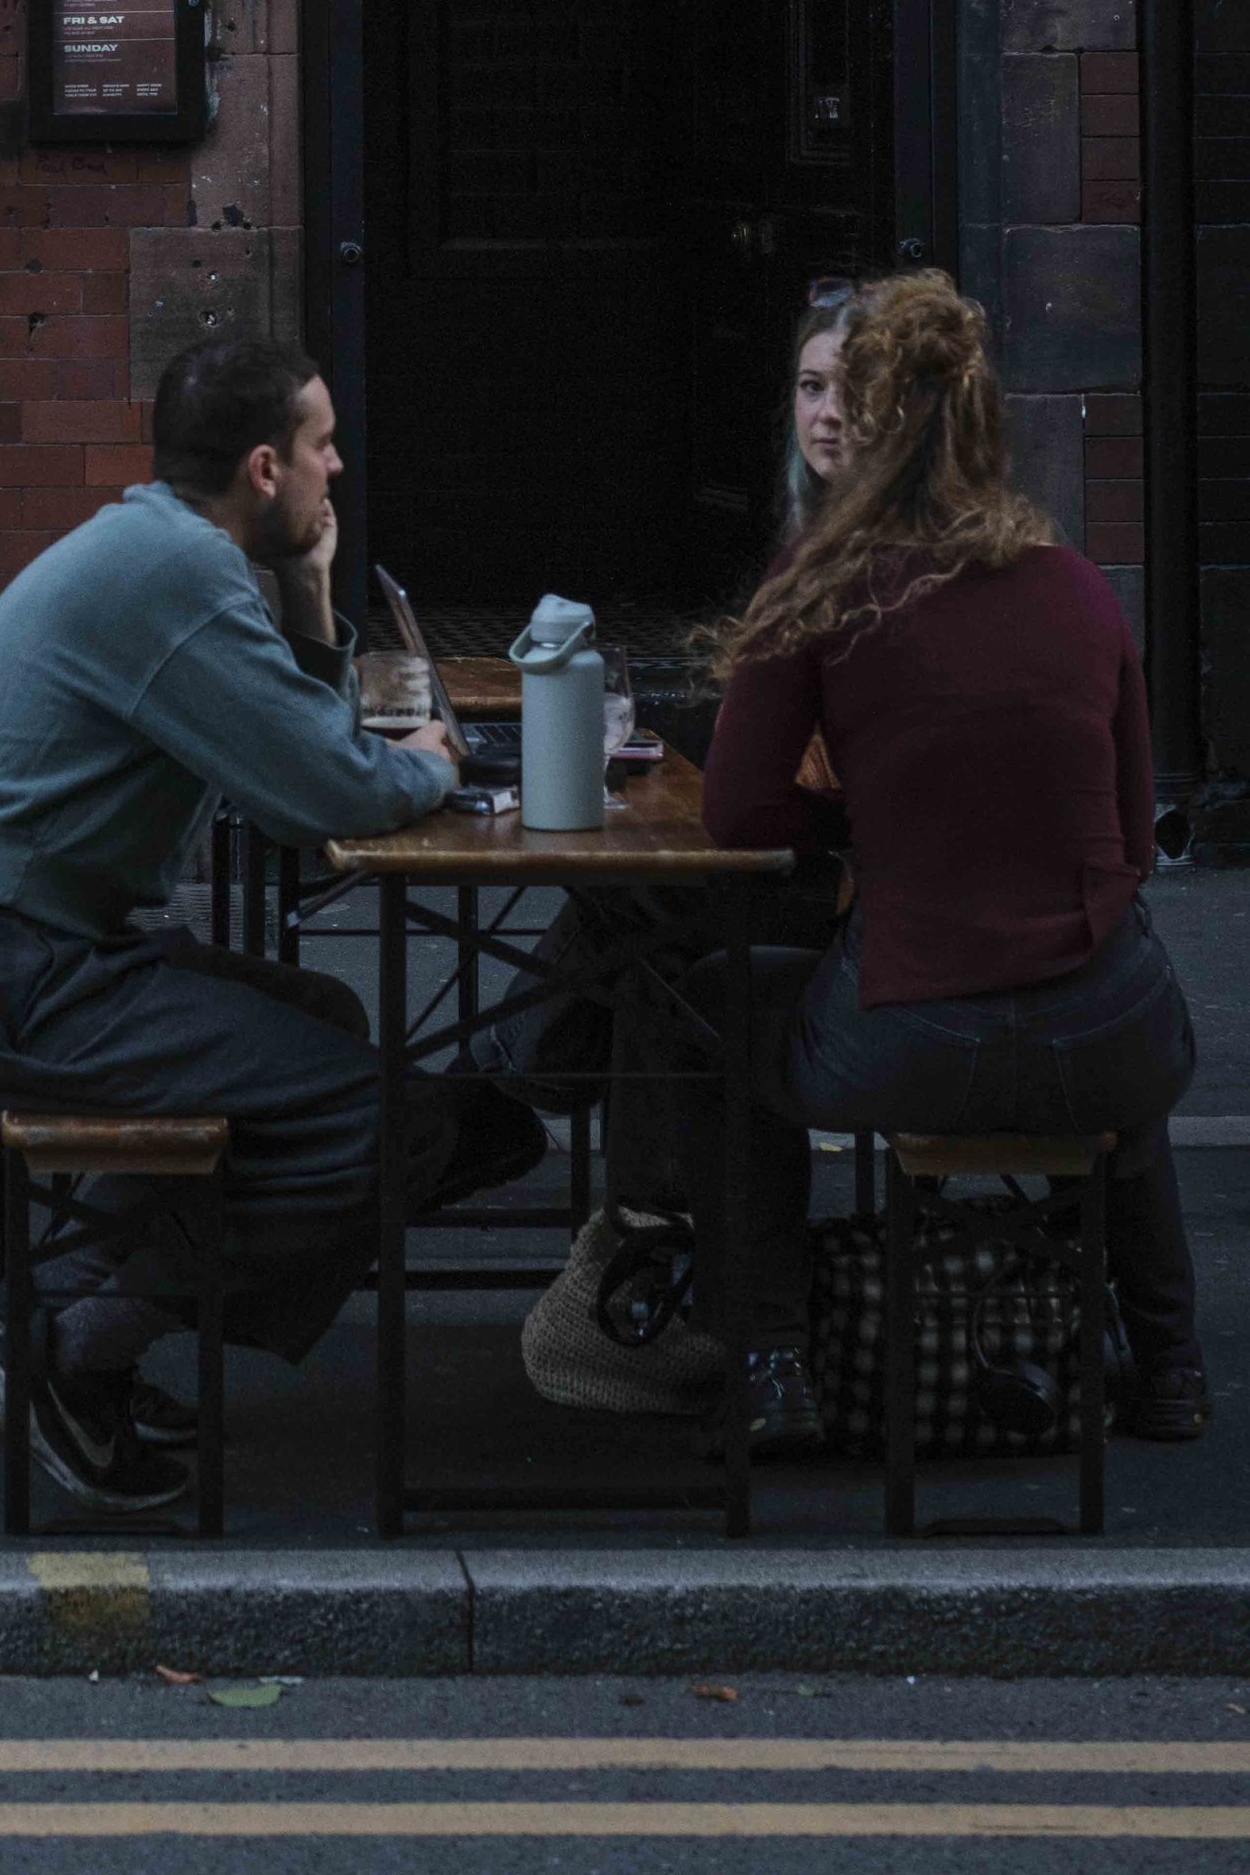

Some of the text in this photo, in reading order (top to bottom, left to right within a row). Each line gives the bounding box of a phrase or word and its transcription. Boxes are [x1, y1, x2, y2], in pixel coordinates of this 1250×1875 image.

[63, 16, 125, 25] FRI & SAT
[64, 43, 118, 53] SUNDAY
